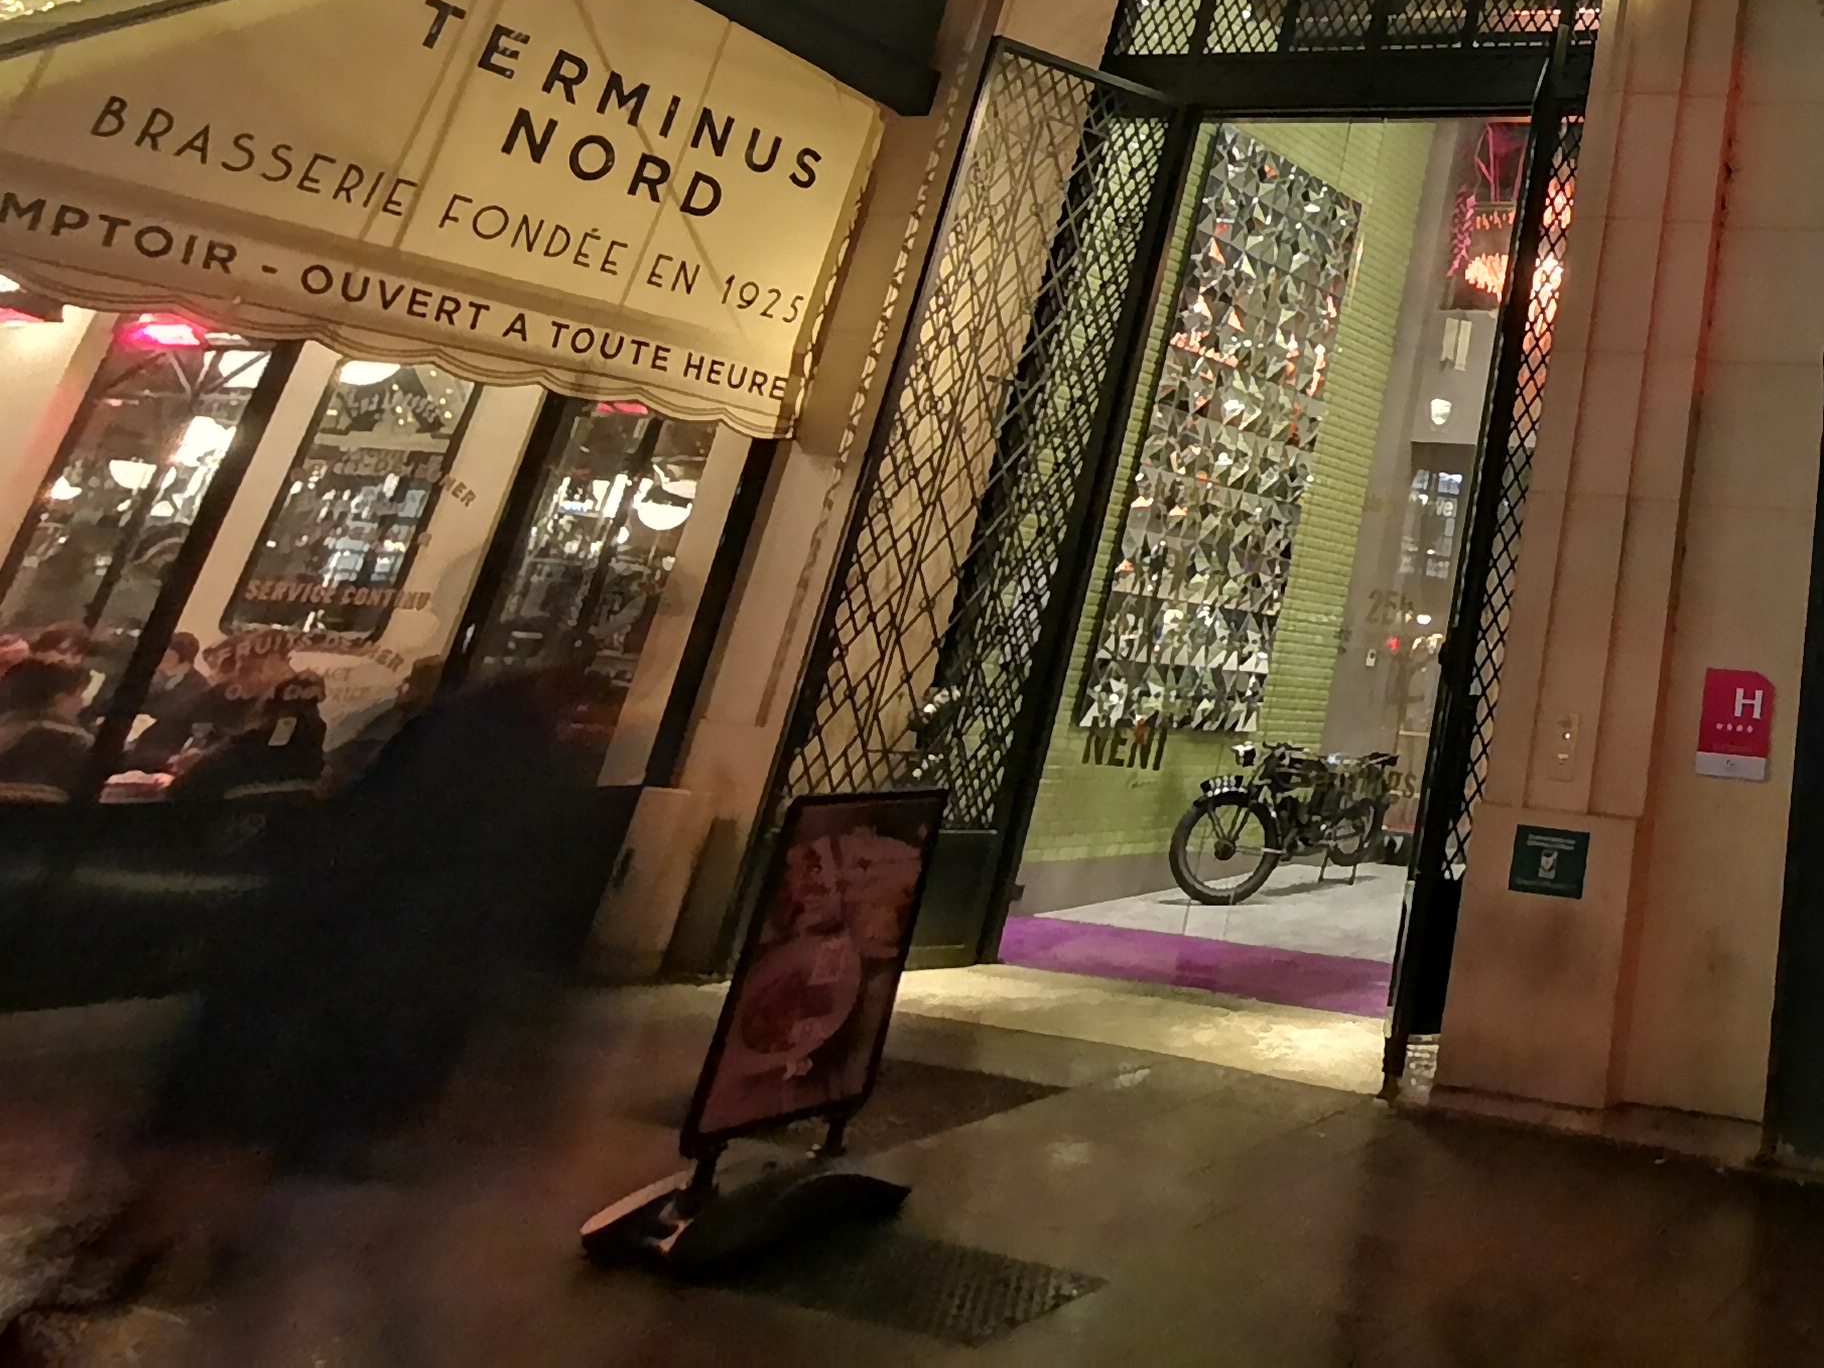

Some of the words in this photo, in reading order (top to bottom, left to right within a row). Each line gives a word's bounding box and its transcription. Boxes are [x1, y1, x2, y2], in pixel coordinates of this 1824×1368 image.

[90, 95, 421, 219] BRASSERIE
[501, 107, 723, 219] NORD
[438, 193, 630, 277] FONDÉE
[648, 256, 701, 297] EN
[720, 273, 806, 326] 1925
[300, 263, 489, 334] OUVERT
[501, 311, 529, 342] A
[549, 323, 671, 374] TOUTE
[683, 350, 790, 400] HEURE
[1734, 688, 1763, 719] H
